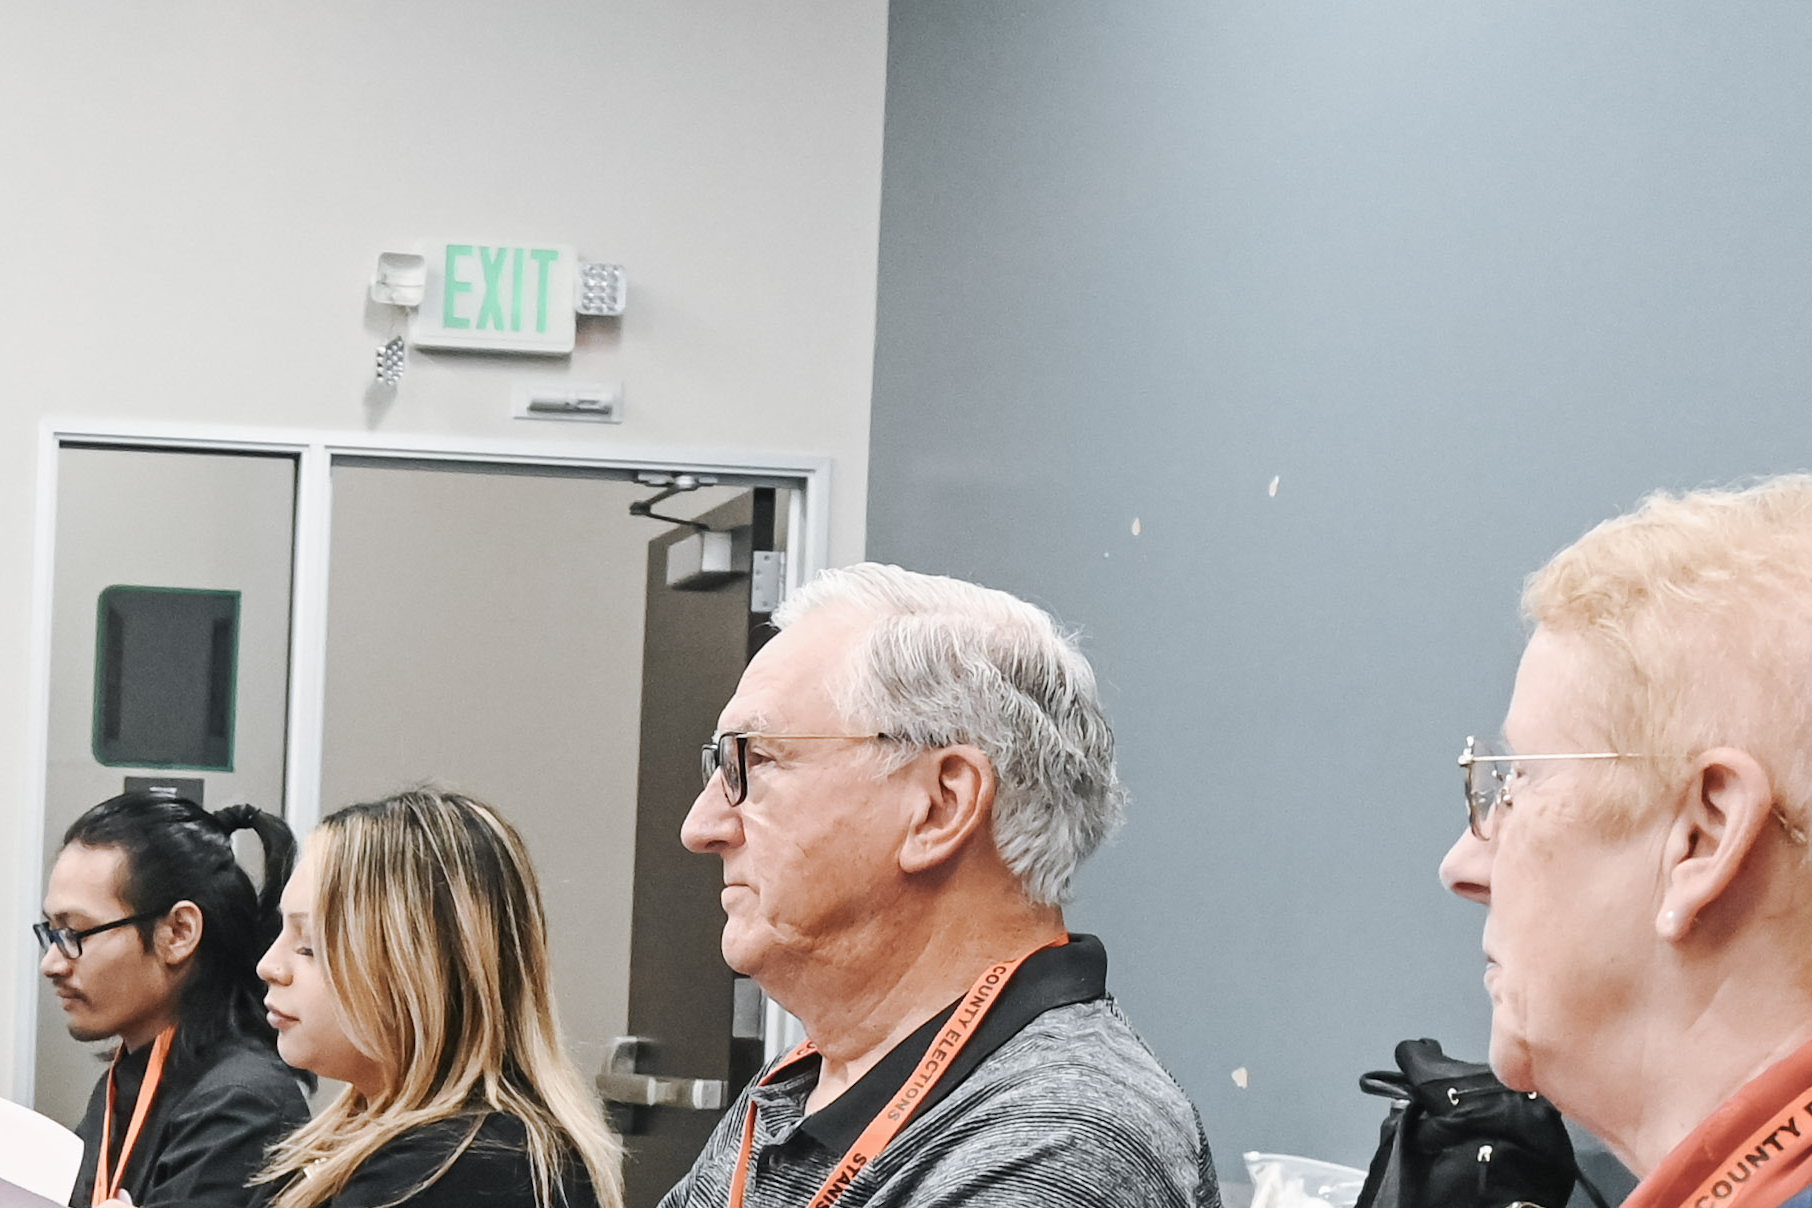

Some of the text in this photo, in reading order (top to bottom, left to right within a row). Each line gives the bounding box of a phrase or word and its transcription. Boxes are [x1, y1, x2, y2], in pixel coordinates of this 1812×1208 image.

[442, 244, 559, 333] EXIT
[888, 965, 1007, 1121] COUNTY ELECTIONS
